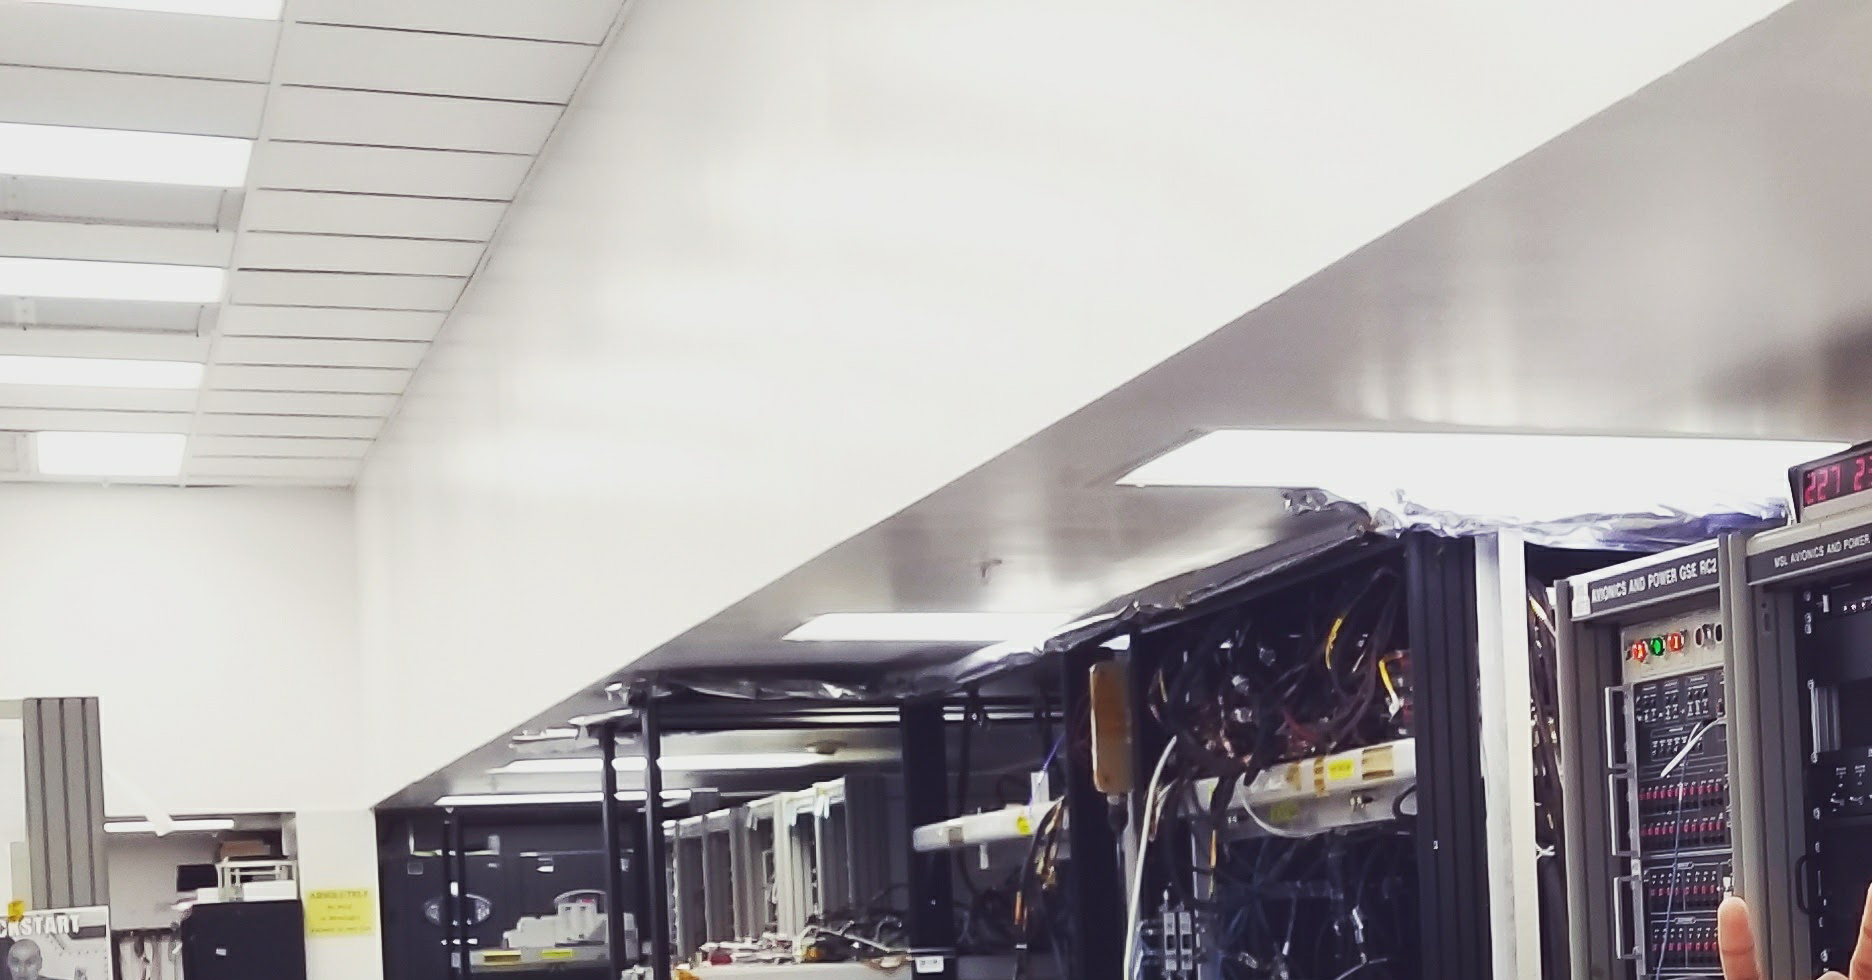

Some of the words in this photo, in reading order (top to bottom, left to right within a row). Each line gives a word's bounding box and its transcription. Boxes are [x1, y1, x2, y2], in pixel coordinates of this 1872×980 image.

[1790, 545, 1825, 563] AVIONICS
[1826, 539, 1842, 554] AND
[1843, 532, 1871, 550] POWER
[1591, 580, 1627, 604] AVIONICS
[1628, 576, 1646, 594] AND
[1647, 567, 1677, 590] POWER
[1679, 562, 1698, 581] GSE
